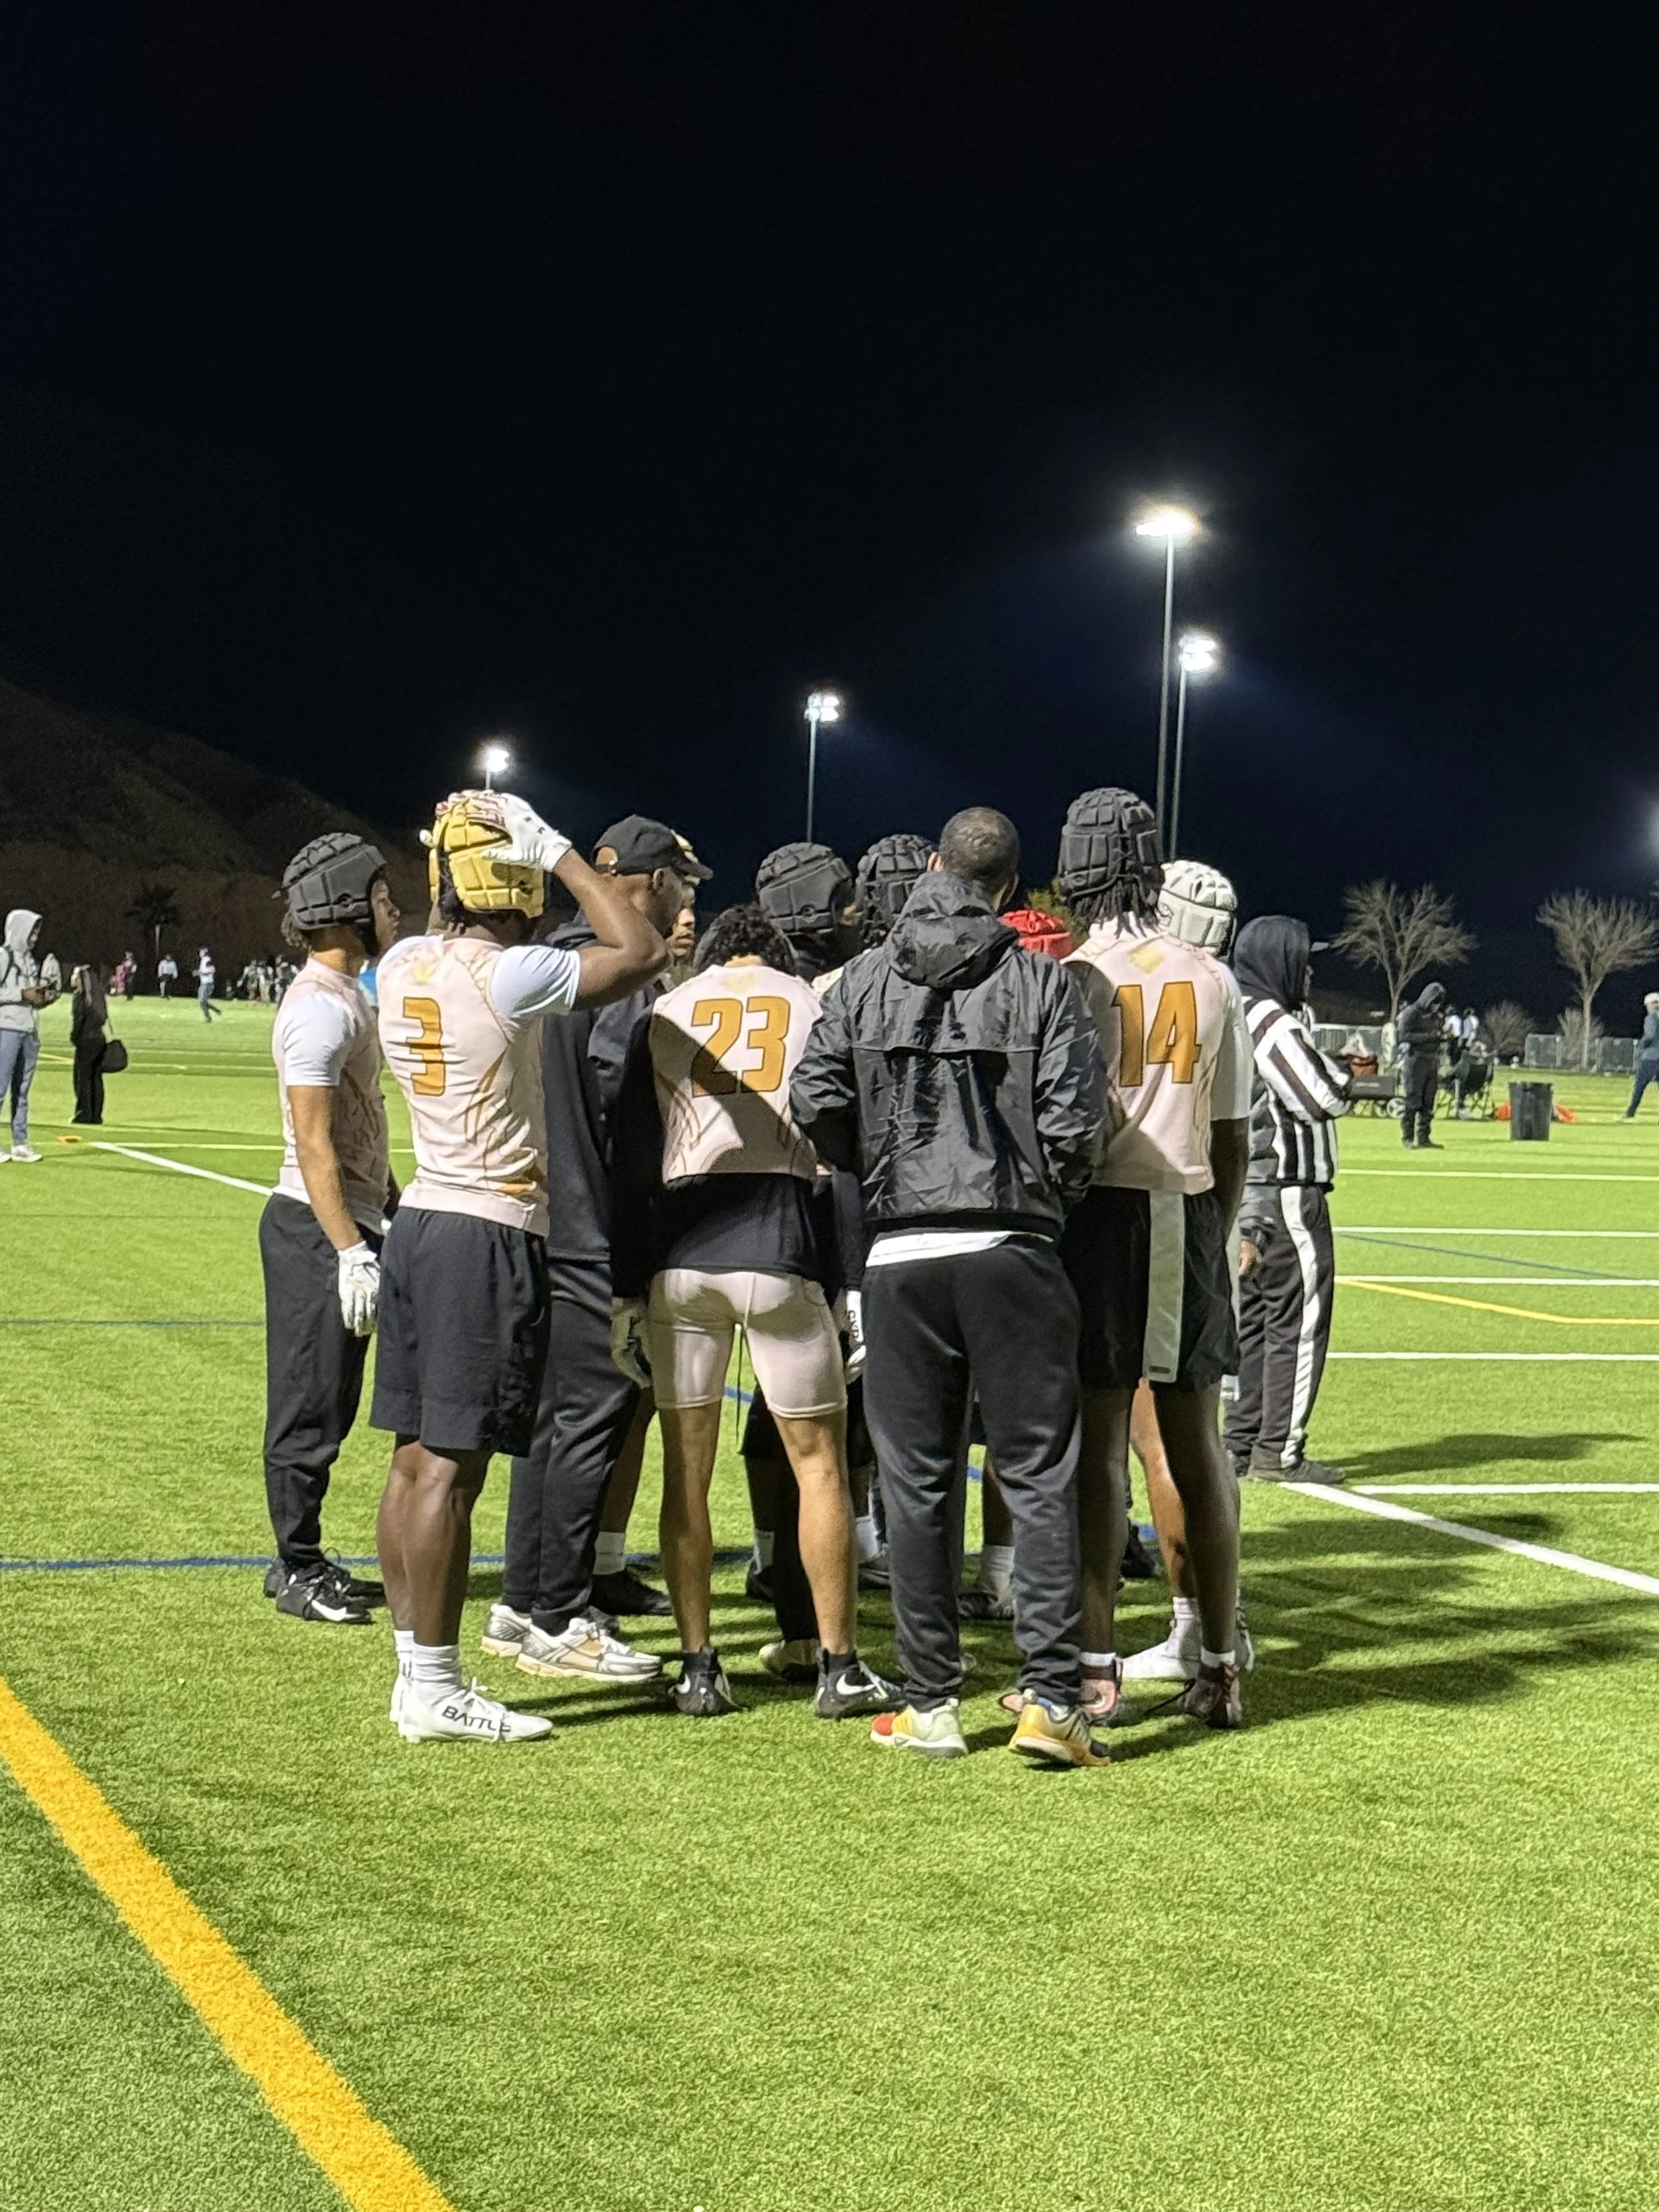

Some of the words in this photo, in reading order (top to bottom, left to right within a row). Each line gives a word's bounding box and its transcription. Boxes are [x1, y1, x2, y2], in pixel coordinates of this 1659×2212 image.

[402, 996, 446, 1097] 3
[691, 995, 791, 1098] 23
[1111, 981, 1202, 1087] 14
[441, 1705, 512, 1733] BATTLE
